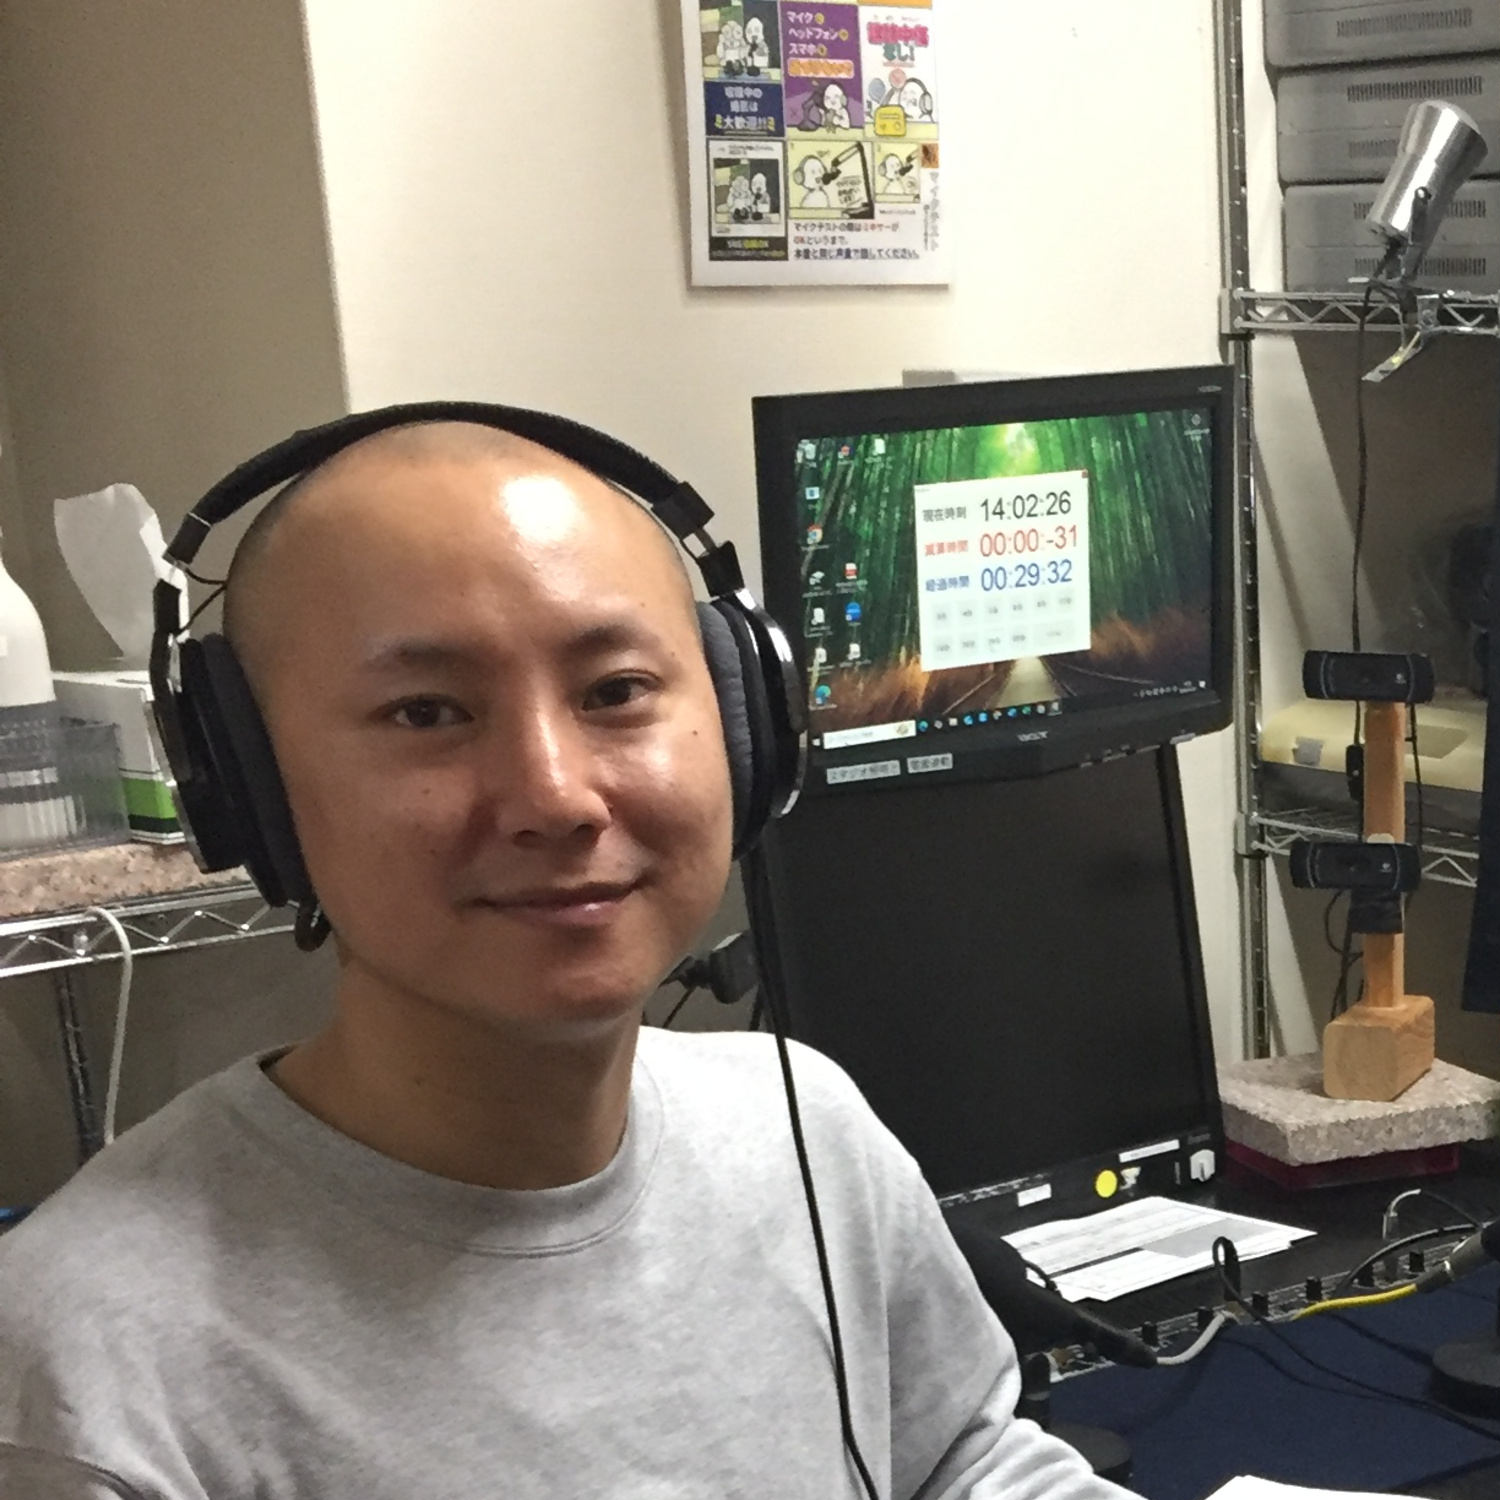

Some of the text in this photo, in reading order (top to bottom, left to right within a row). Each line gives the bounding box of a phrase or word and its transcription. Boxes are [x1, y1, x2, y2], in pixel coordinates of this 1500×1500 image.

[980, 490, 1072, 522] 14:02:26
[979, 524, 1077, 557] 00:00:-31
[980, 558, 1073, 592] 00:29:32
